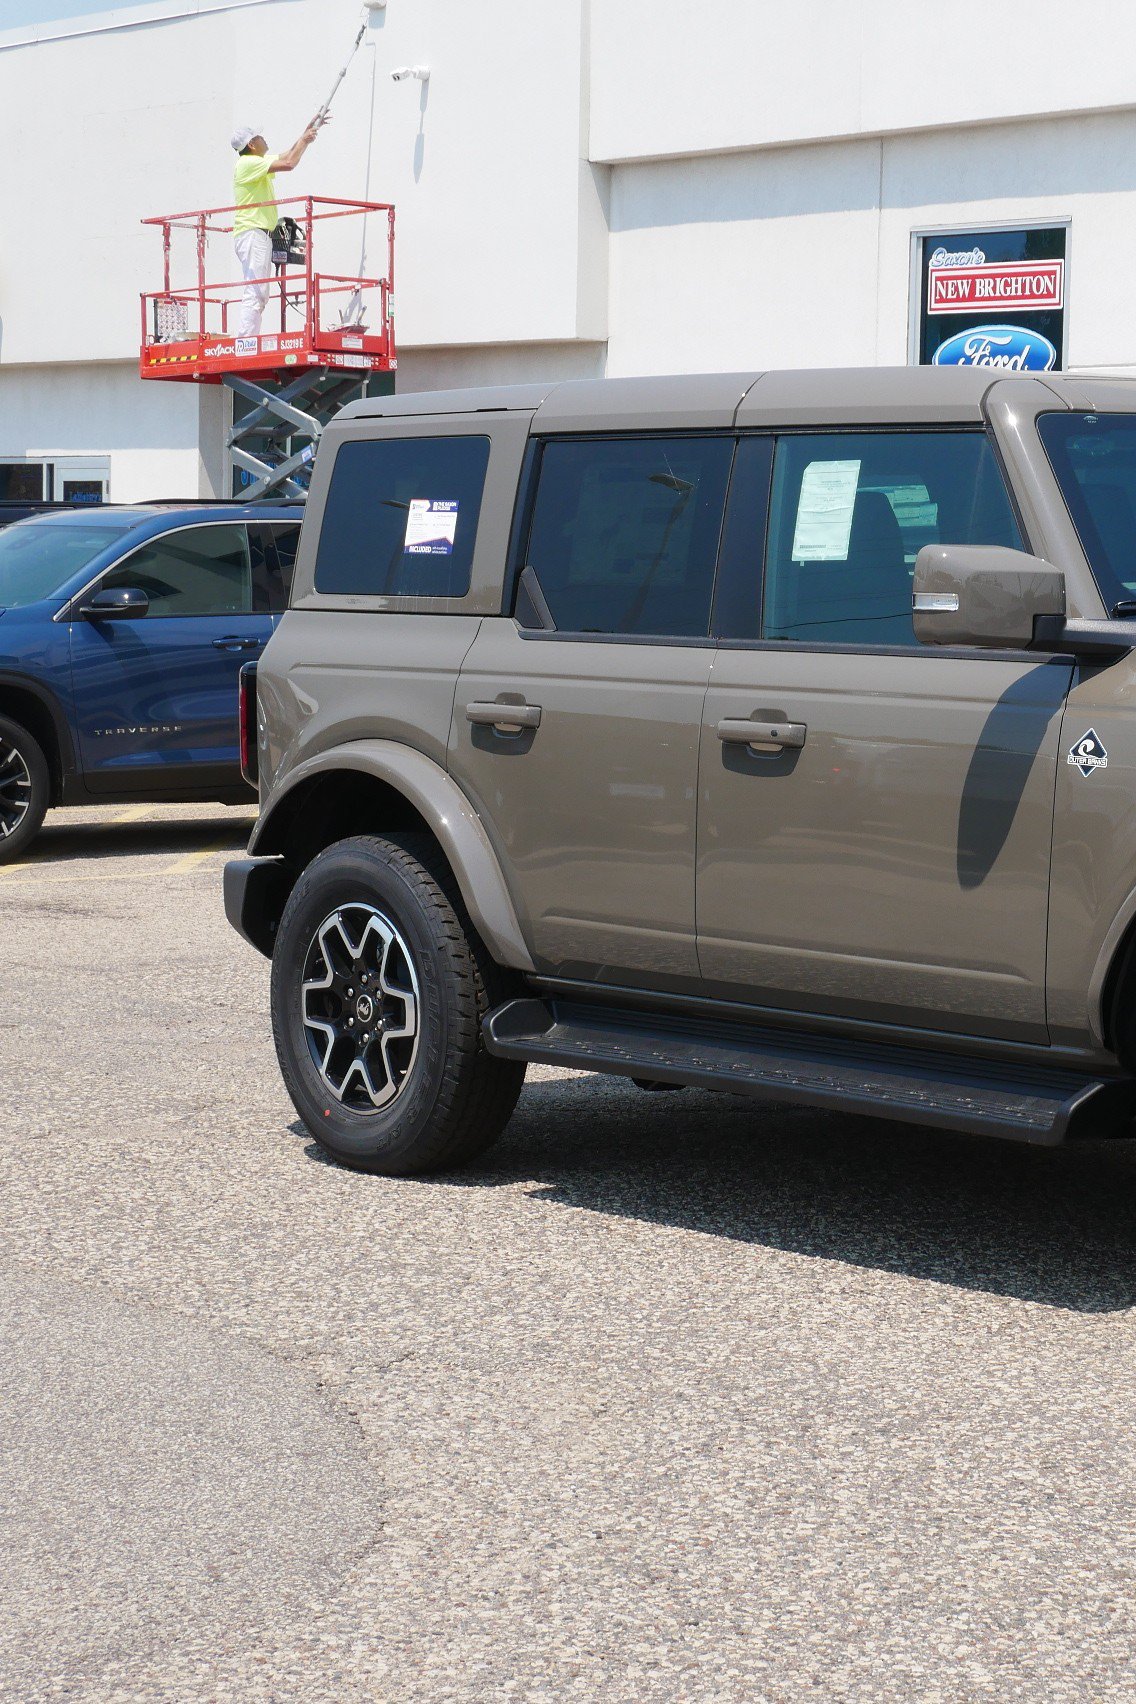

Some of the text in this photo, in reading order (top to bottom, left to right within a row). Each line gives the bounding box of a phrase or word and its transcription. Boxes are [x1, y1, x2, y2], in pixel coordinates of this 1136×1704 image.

[930, 247, 984, 267] Saxon's
[935, 274, 1056, 299] NEW BRIGHTON
[204, 344, 235, 357] SKYJACK
[958, 334, 1031, 371] Ford
[94, 726, 182, 736] TRAVERSE
